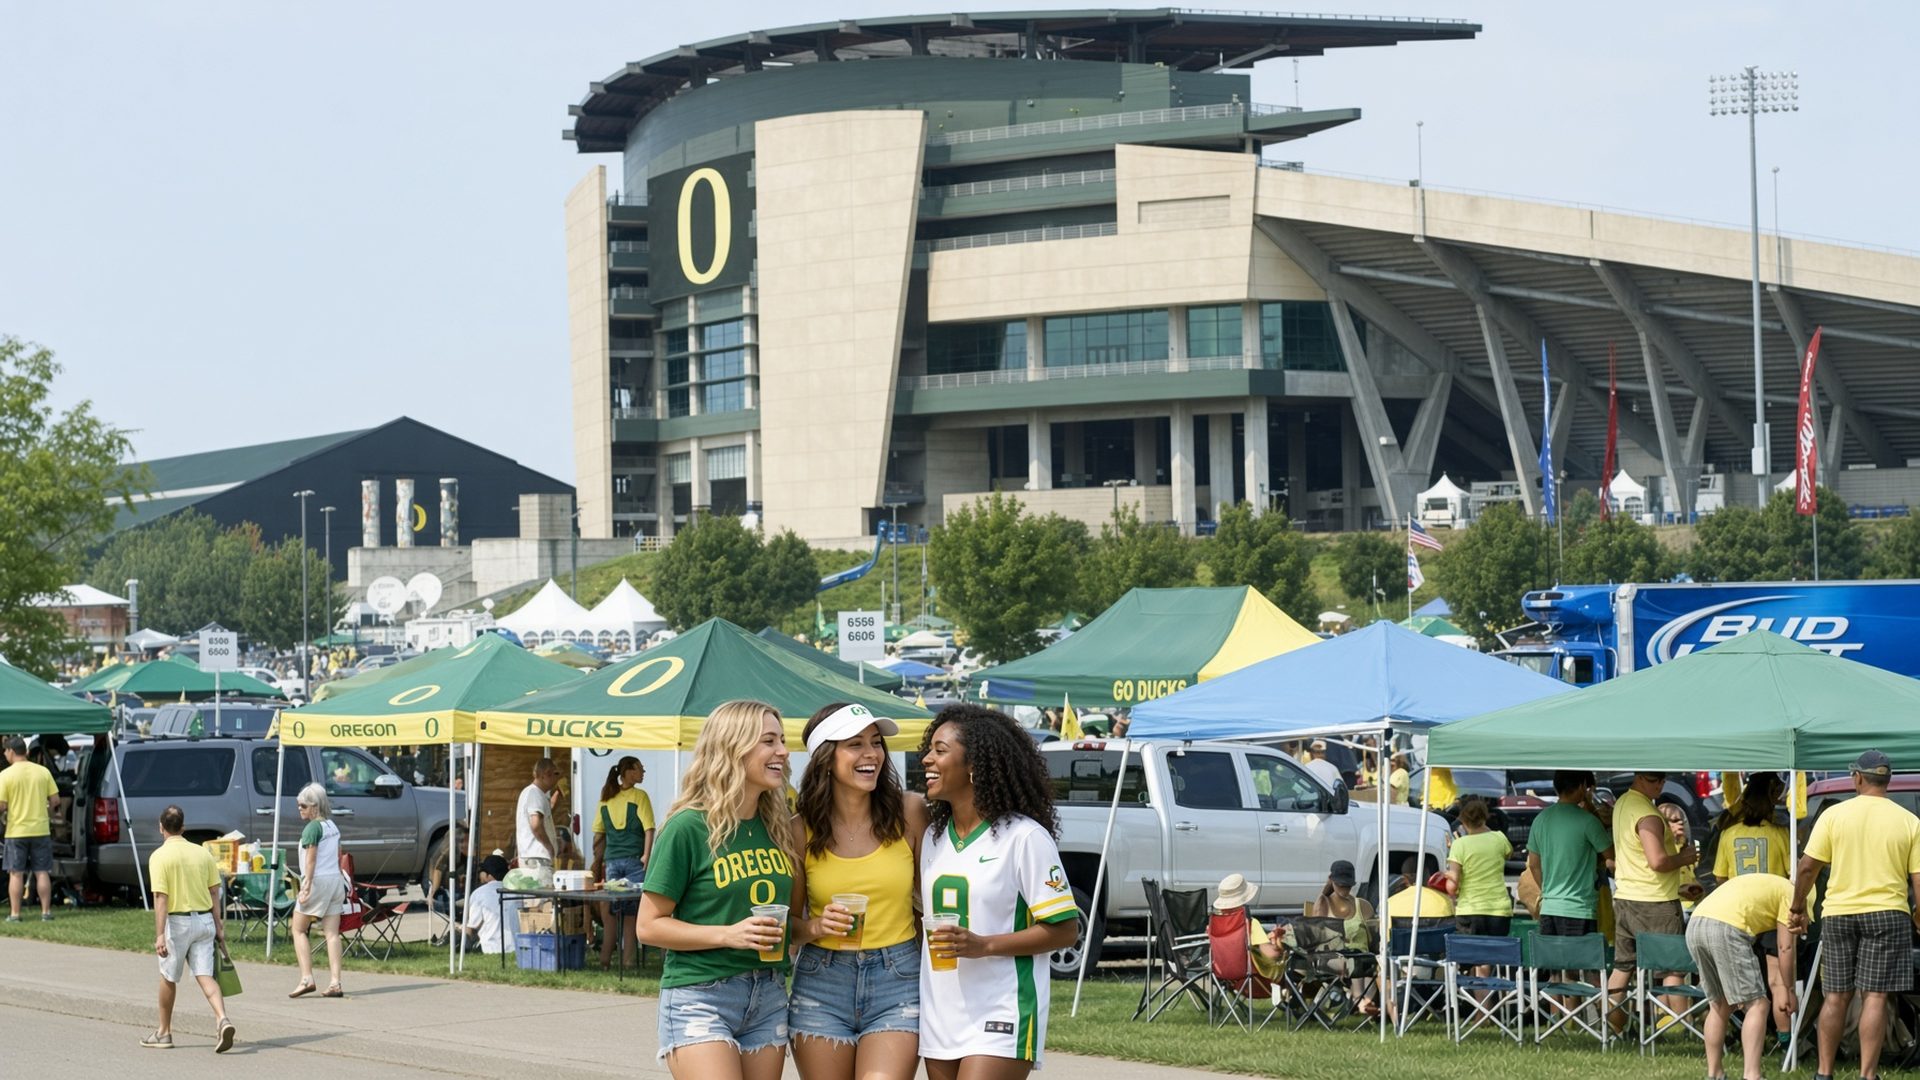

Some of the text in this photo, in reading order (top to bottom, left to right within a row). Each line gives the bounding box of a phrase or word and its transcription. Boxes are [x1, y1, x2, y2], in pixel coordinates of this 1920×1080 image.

[1699, 615, 1850, 642] BUD
[1113, 679, 1134, 701] GO
[330, 723, 397, 737] OREGON
[526, 718, 624, 738] DUCKS
[1734, 837, 1768, 876] 21
